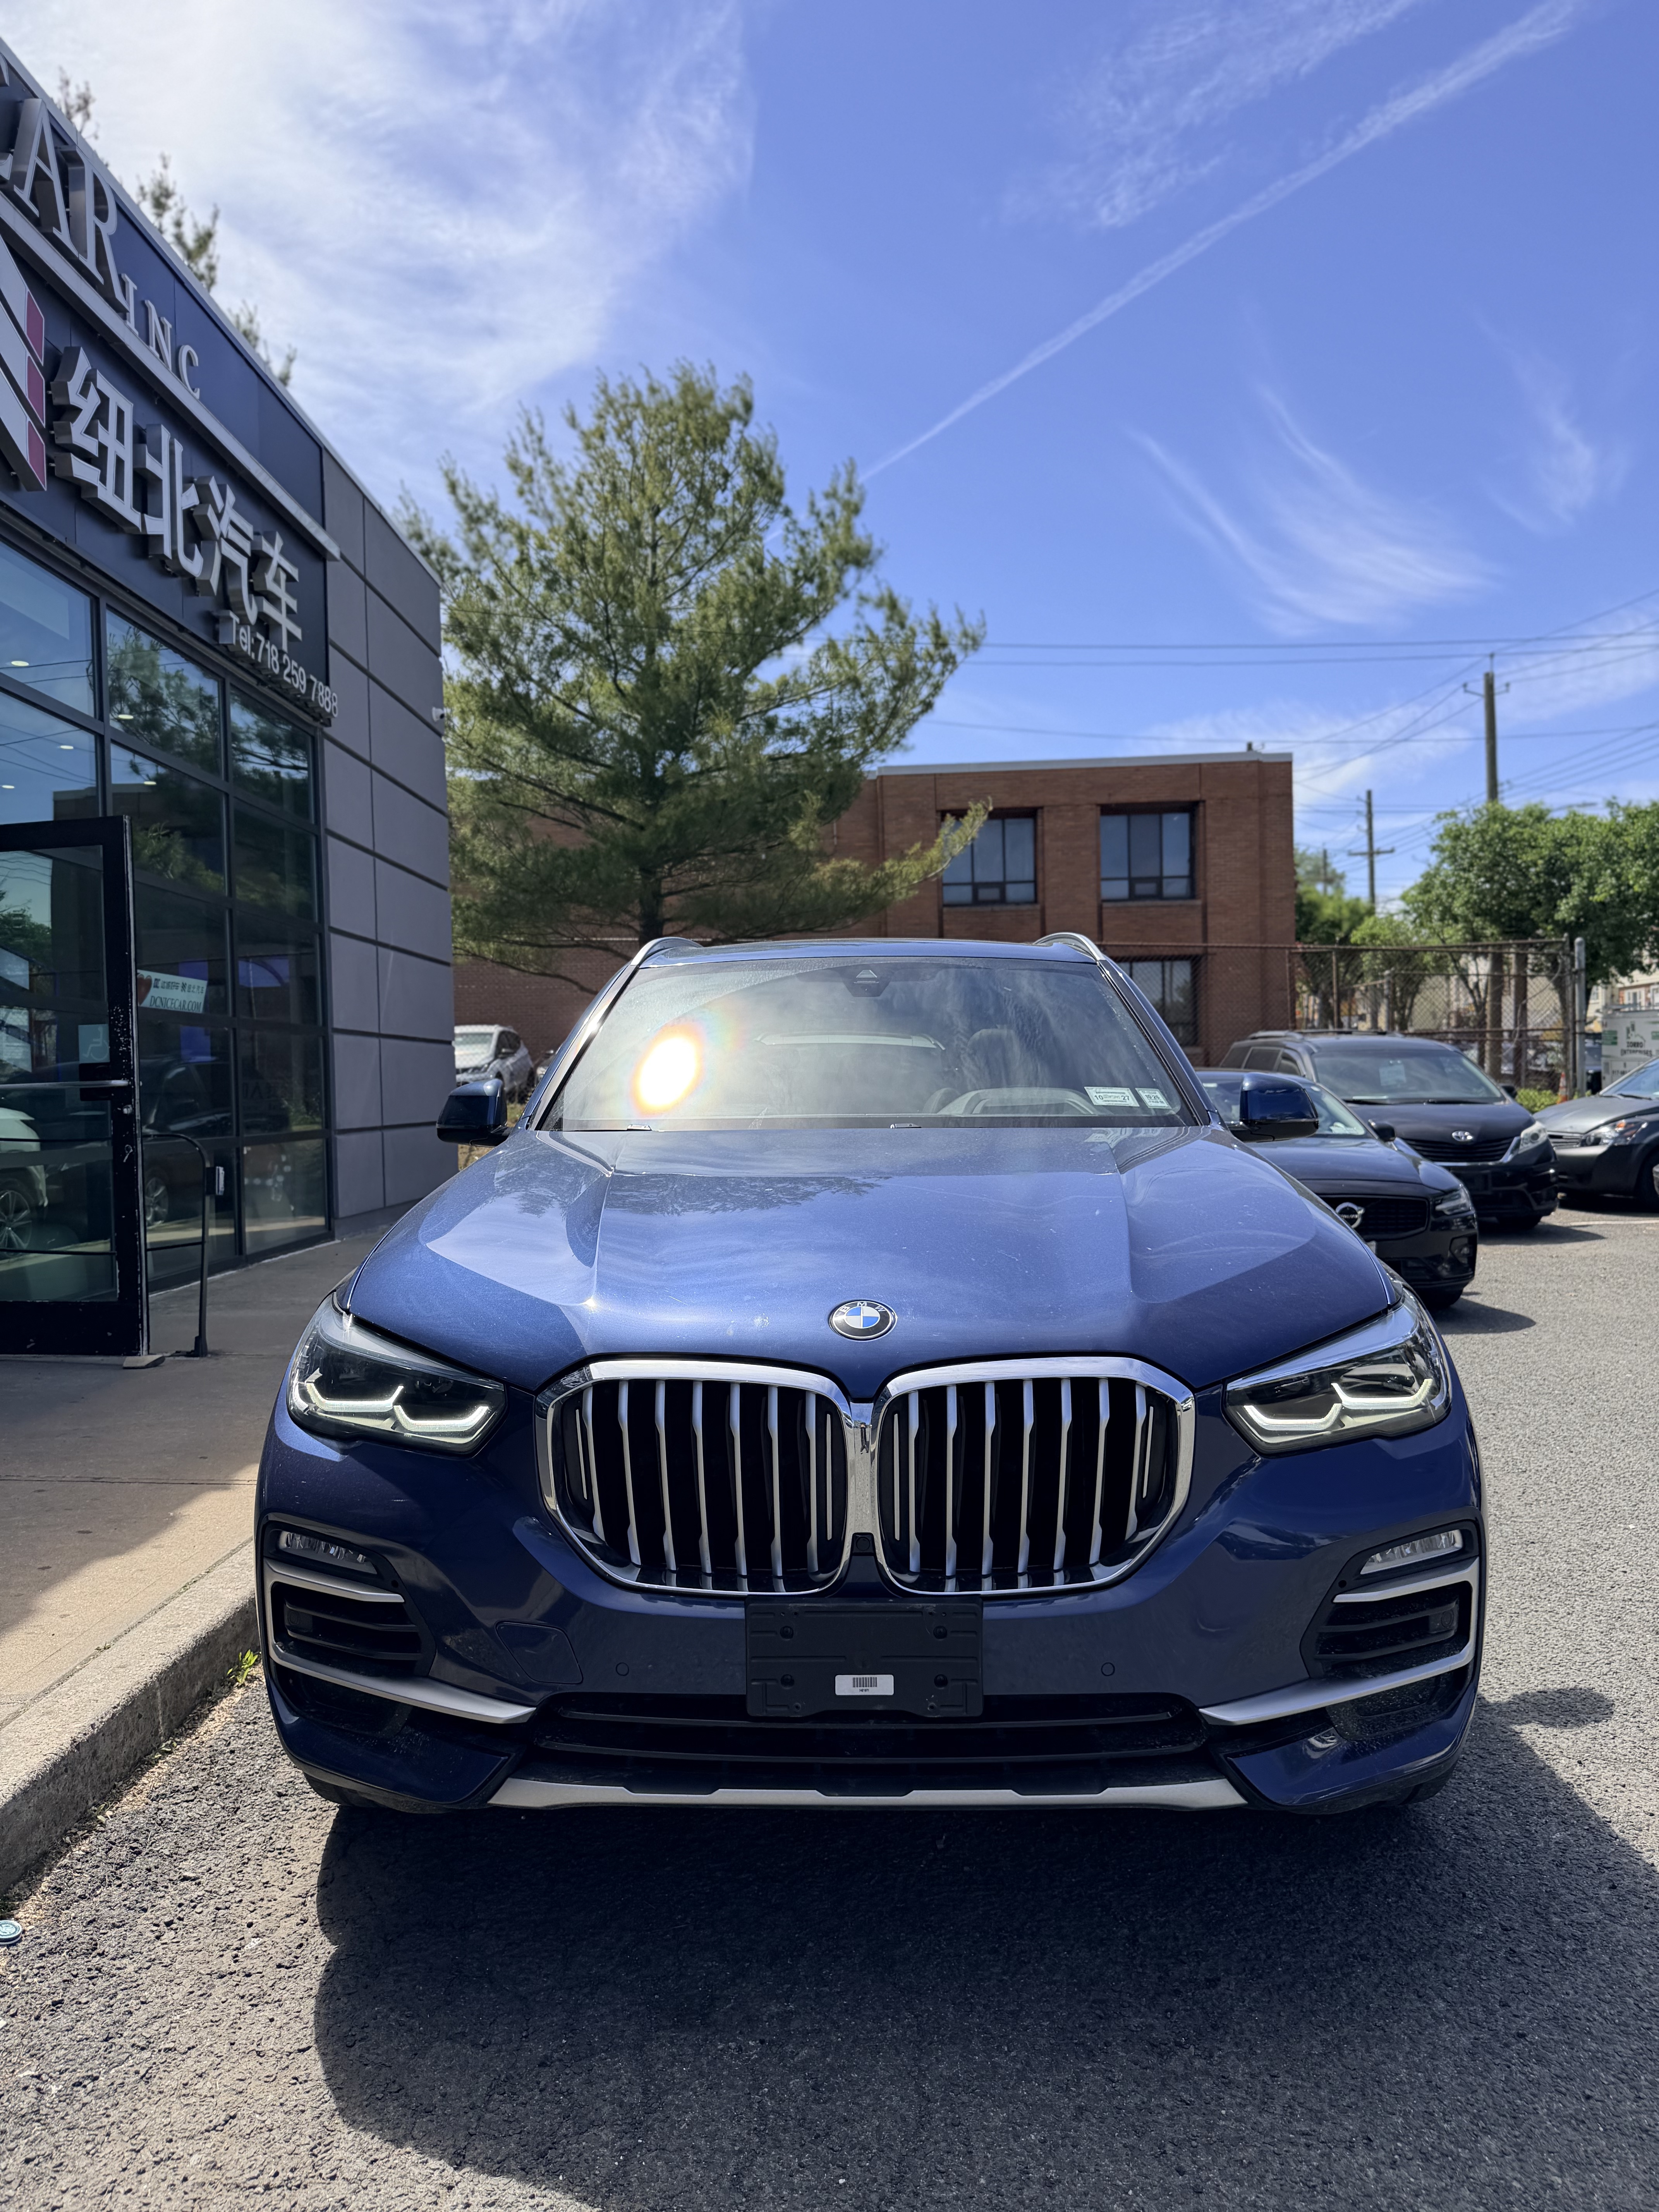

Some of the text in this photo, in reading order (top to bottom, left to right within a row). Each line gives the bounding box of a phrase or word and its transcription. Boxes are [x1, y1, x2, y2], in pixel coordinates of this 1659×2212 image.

[0, 53, 199, 400] AR INC
[66, 347, 302, 651] 纽北汽车
[283, 654, 307, 694] 259
[310, 674, 338, 717] 7888
[150, 996, 201, 1012] DCNICECAR.COM
[1621, 1049, 1652, 1057] ENTERPRISES
[839, 1301, 886, 1312] BMW
